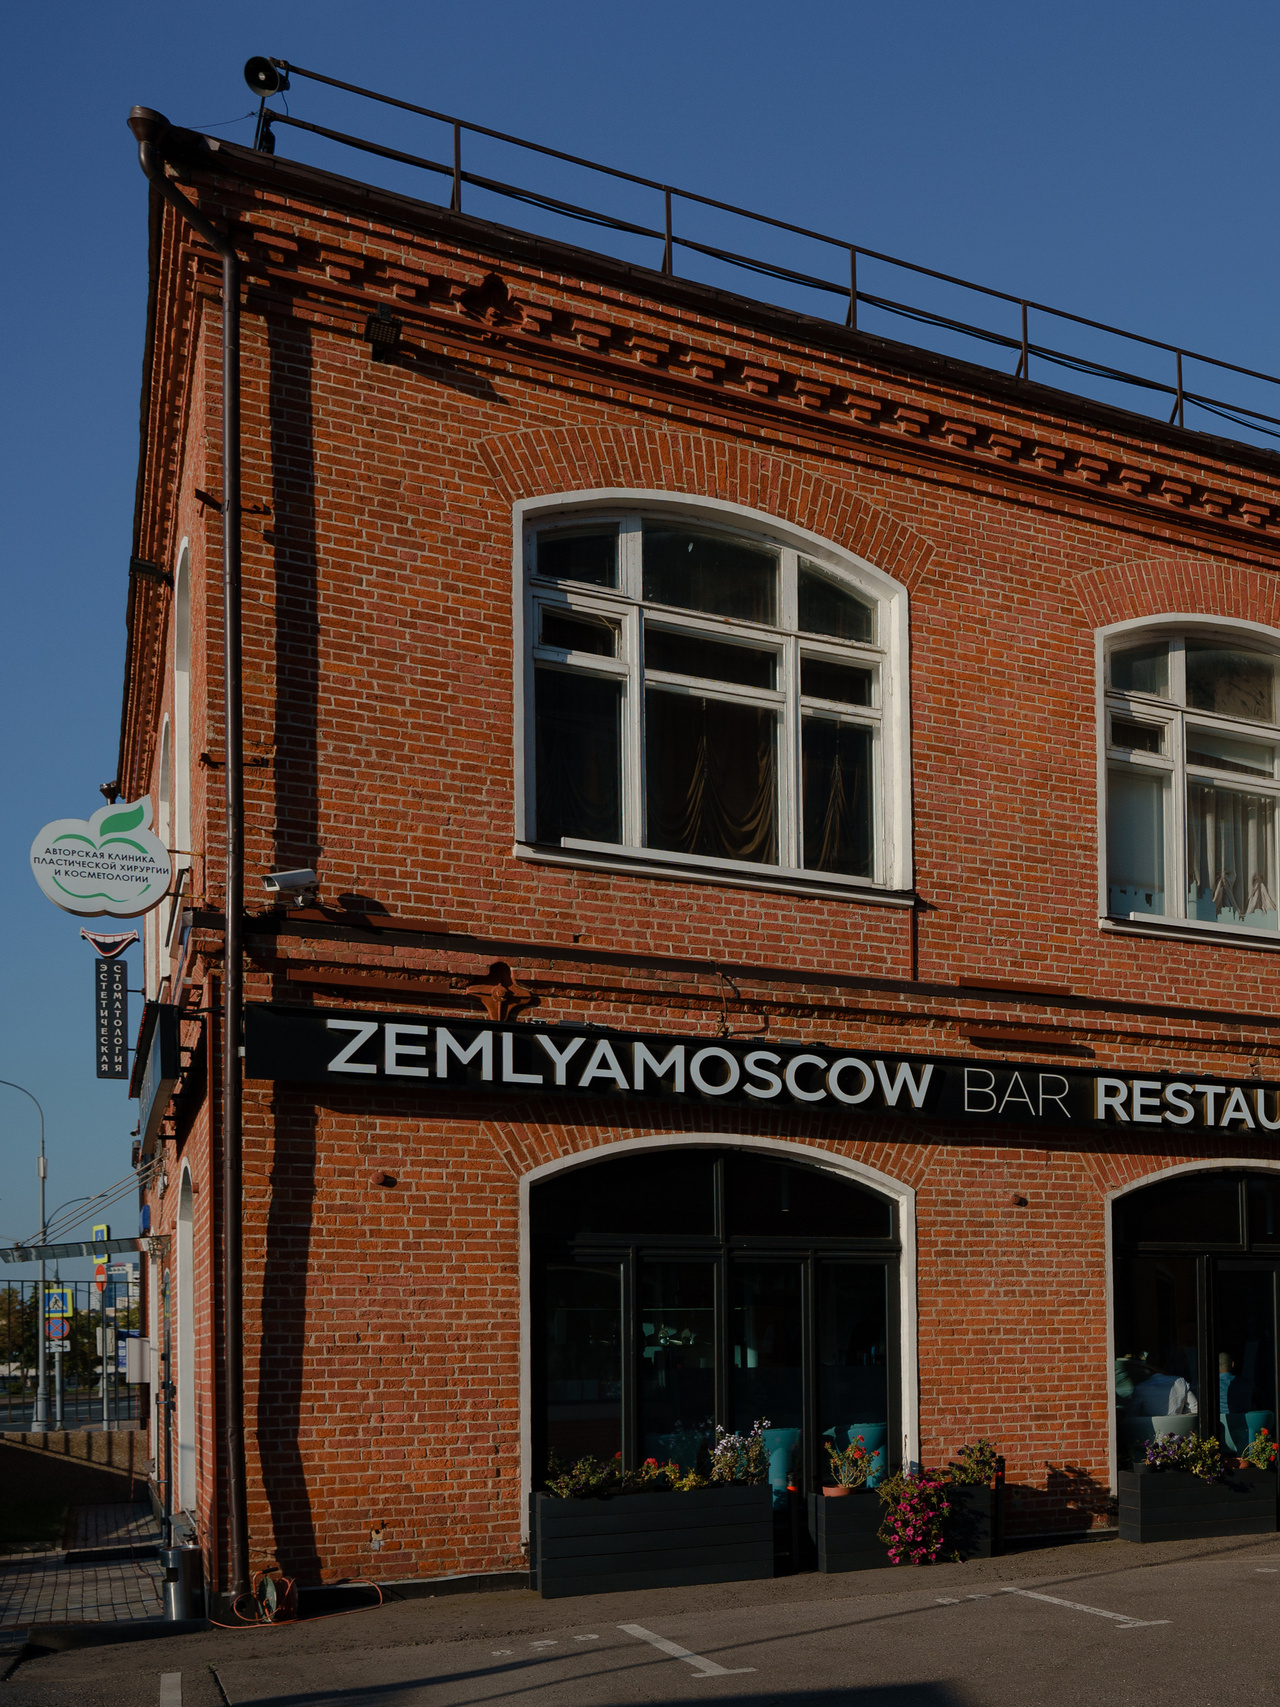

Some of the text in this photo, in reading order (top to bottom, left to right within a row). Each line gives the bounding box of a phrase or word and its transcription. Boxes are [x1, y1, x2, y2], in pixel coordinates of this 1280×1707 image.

[33, 856, 170, 875] ПЛАСТИЧЕСКОЙ ХИРУРГИИ
[44, 847, 156, 864] АВТОРСКАЯ КЛИНИКА
[53, 868, 149, 883] И КОСМЕТОЛОГИИ
[99, 964, 109, 1072] ЭСТЕТИЧЕСКАЯ
[113, 965, 123, 1072] СТОМАТОЛОГИЯ
[327, 1019, 935, 1108] ZEMLYAMOSCOW
[964, 1067, 1071, 1118] BAR
